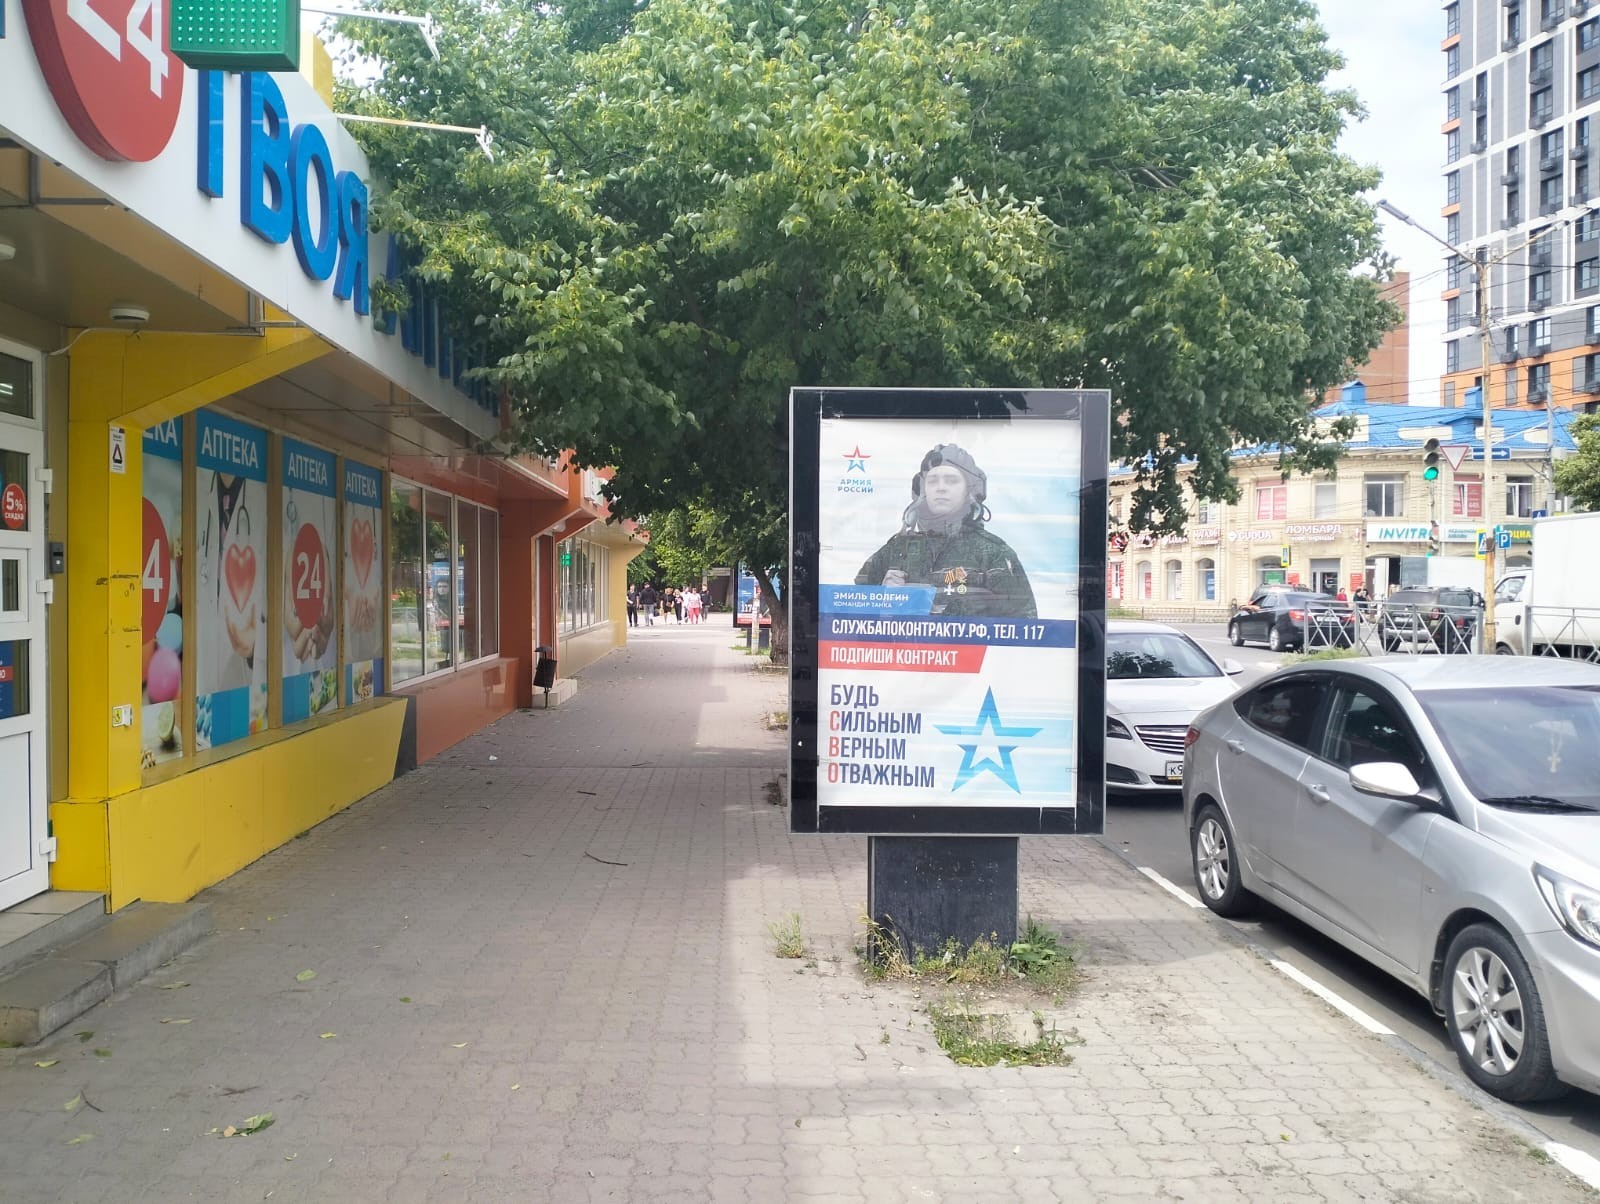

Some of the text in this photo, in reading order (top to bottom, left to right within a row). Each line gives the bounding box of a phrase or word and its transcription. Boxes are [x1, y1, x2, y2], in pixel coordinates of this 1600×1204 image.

[201, 426, 259, 468] АПТЕКА
[287, 452, 329, 487] АПТЕКА
[345, 471, 377, 497] АПТЕКА
[840, 478, 872, 486] АРМИЯ
[6, 491, 23, 512] 5%
[1285, 523, 1342, 535] ЛОМБАРД
[296, 551, 322, 600] 24
[833, 592, 909, 601] ЭМИЛЬ ВОЛГИН
[831, 619, 1045, 640] СЛУЖБАПОКОНТРАКТУ.РФ, ТЕЛ. 117
[830, 646, 958, 666] ПОДПИШИ КОНТРАКТ
[830, 684, 879, 709] БУДЬ
[829, 710, 922, 735] СИЛЬНЫМ
[828, 736, 907, 760] ВЕРНЫМ
[827, 762, 935, 788] ОТВАЖНЫМ
